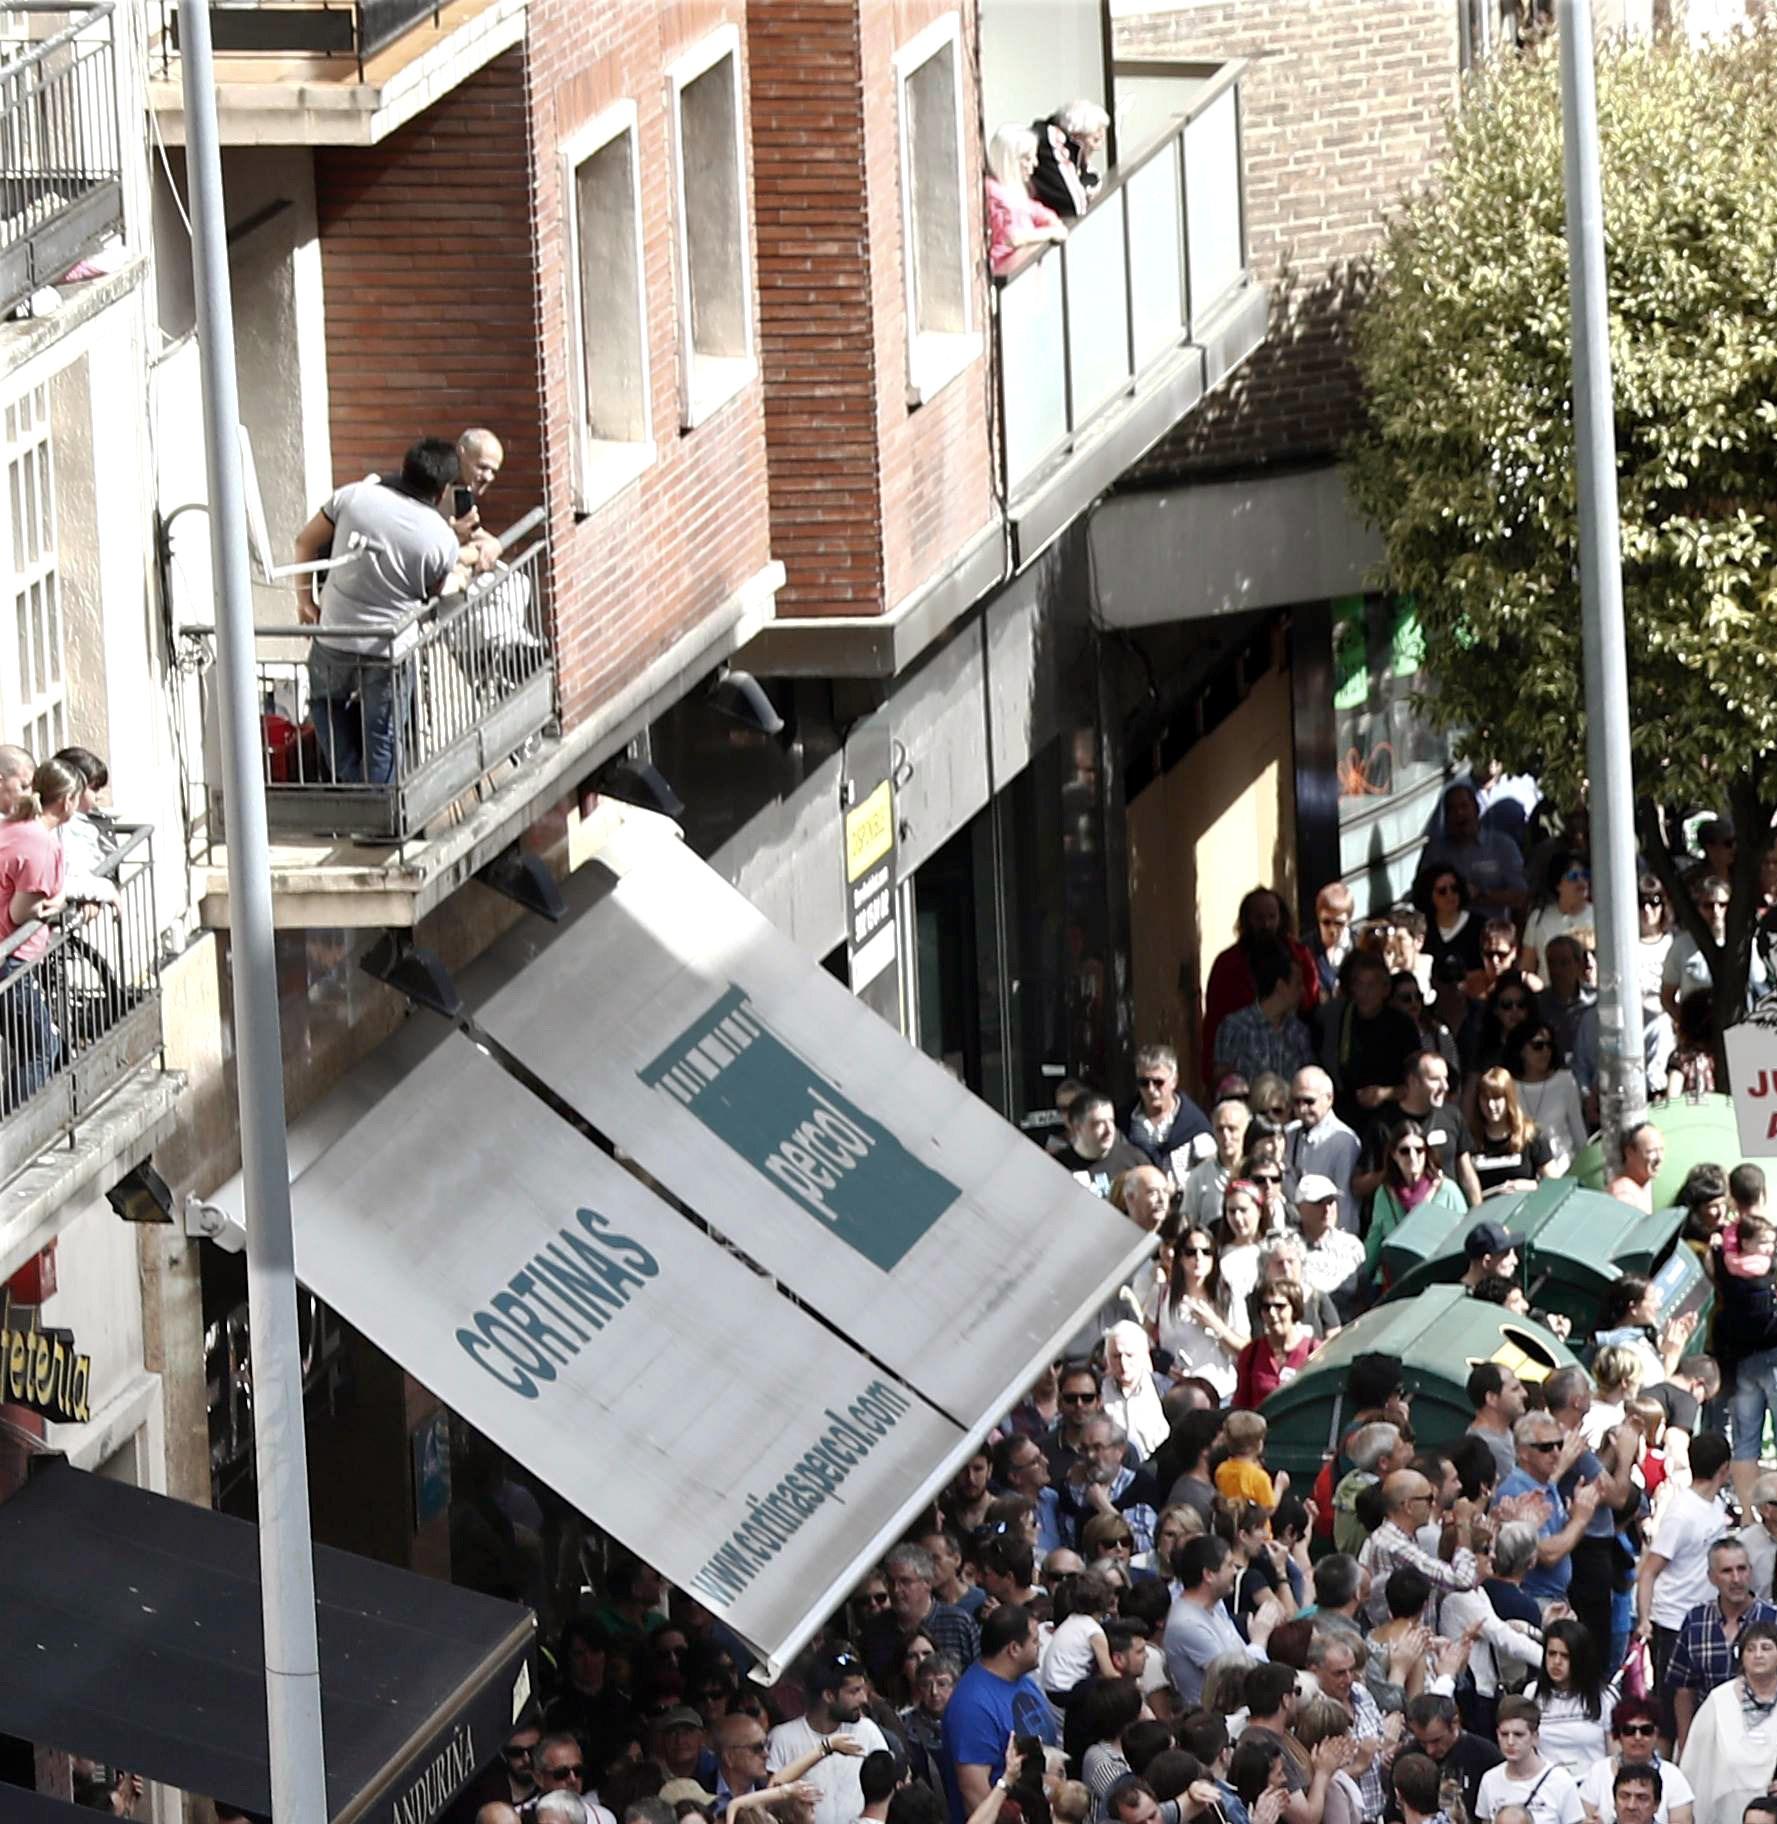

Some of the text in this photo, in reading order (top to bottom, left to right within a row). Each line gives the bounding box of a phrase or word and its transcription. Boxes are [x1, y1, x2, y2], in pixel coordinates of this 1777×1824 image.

[764, 1086, 876, 1221] percol
[455, 1207, 660, 1400] CORTINAS
[690, 1380, 912, 1608] www.cortinaspercol.com
